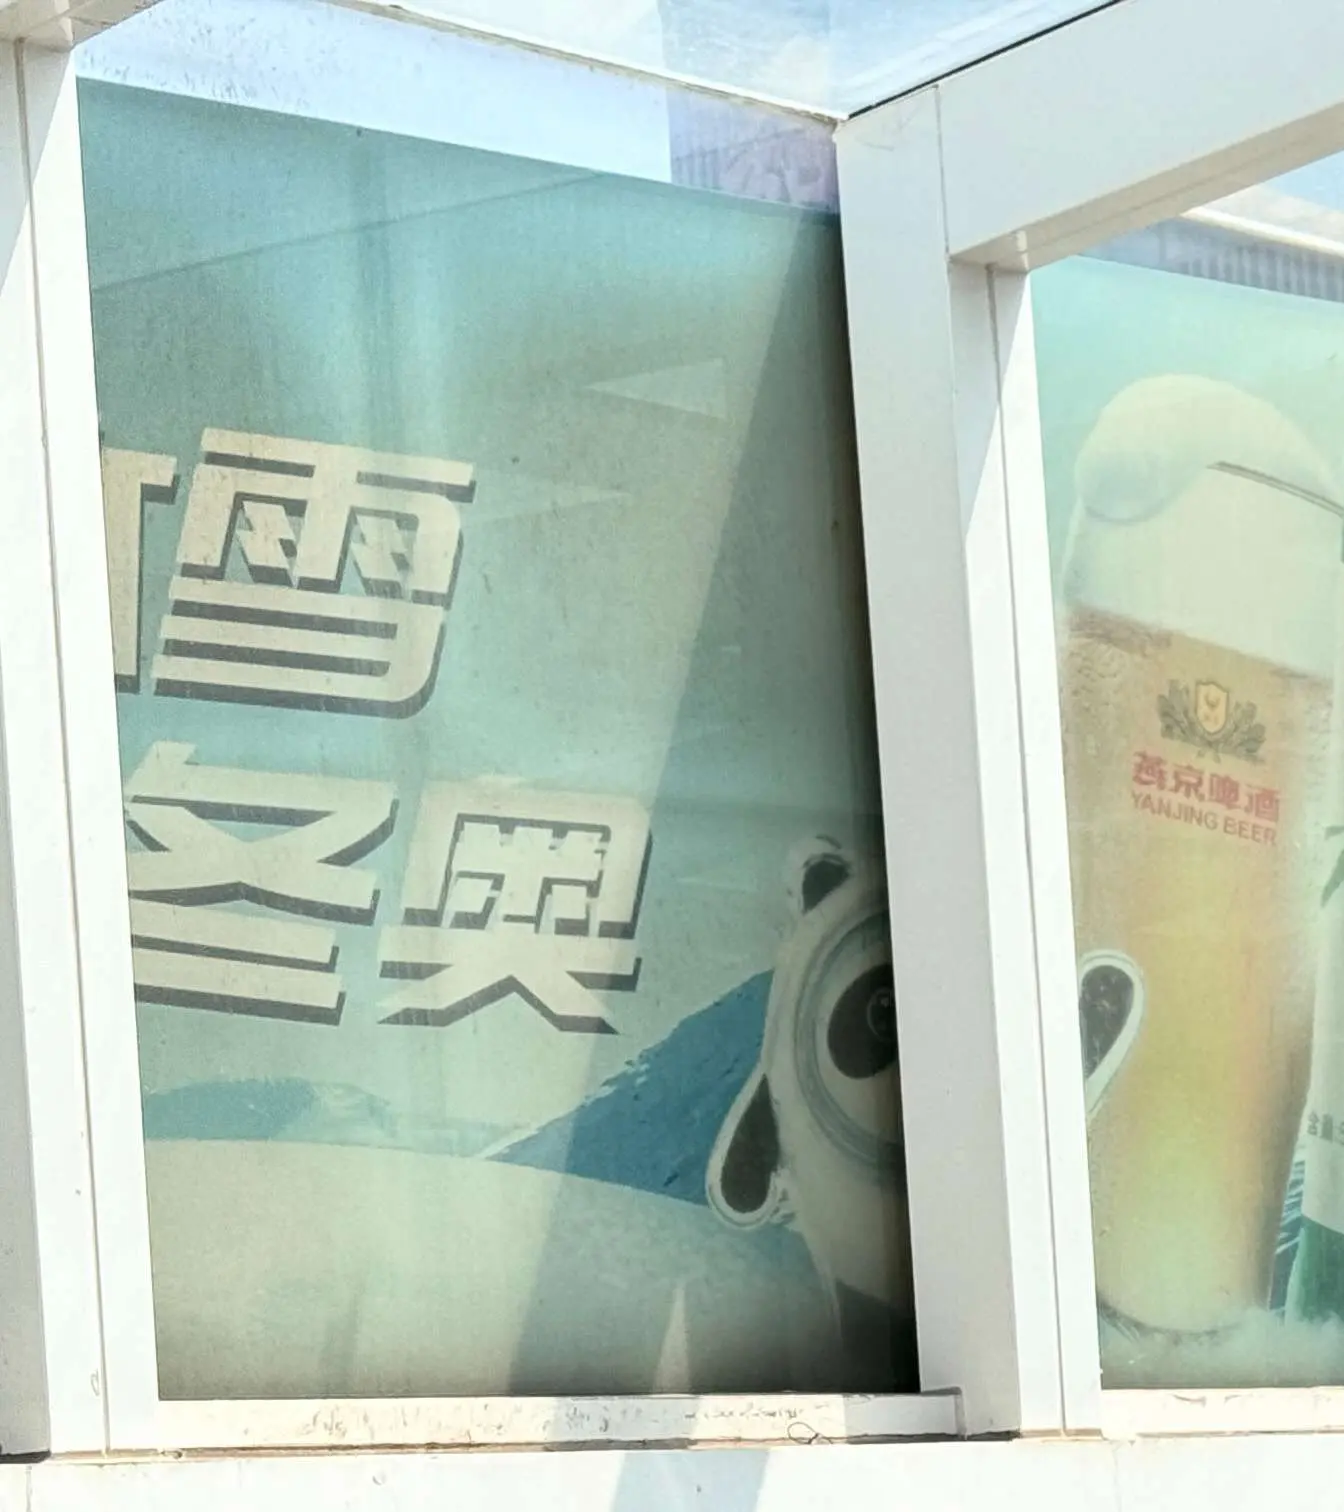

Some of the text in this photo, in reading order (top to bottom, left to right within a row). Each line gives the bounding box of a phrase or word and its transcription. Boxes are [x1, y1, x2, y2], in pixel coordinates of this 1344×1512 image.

[1133, 750, 1281, 822] 燕京啤酒
[1132, 791, 1277, 846] YANJING BEER
